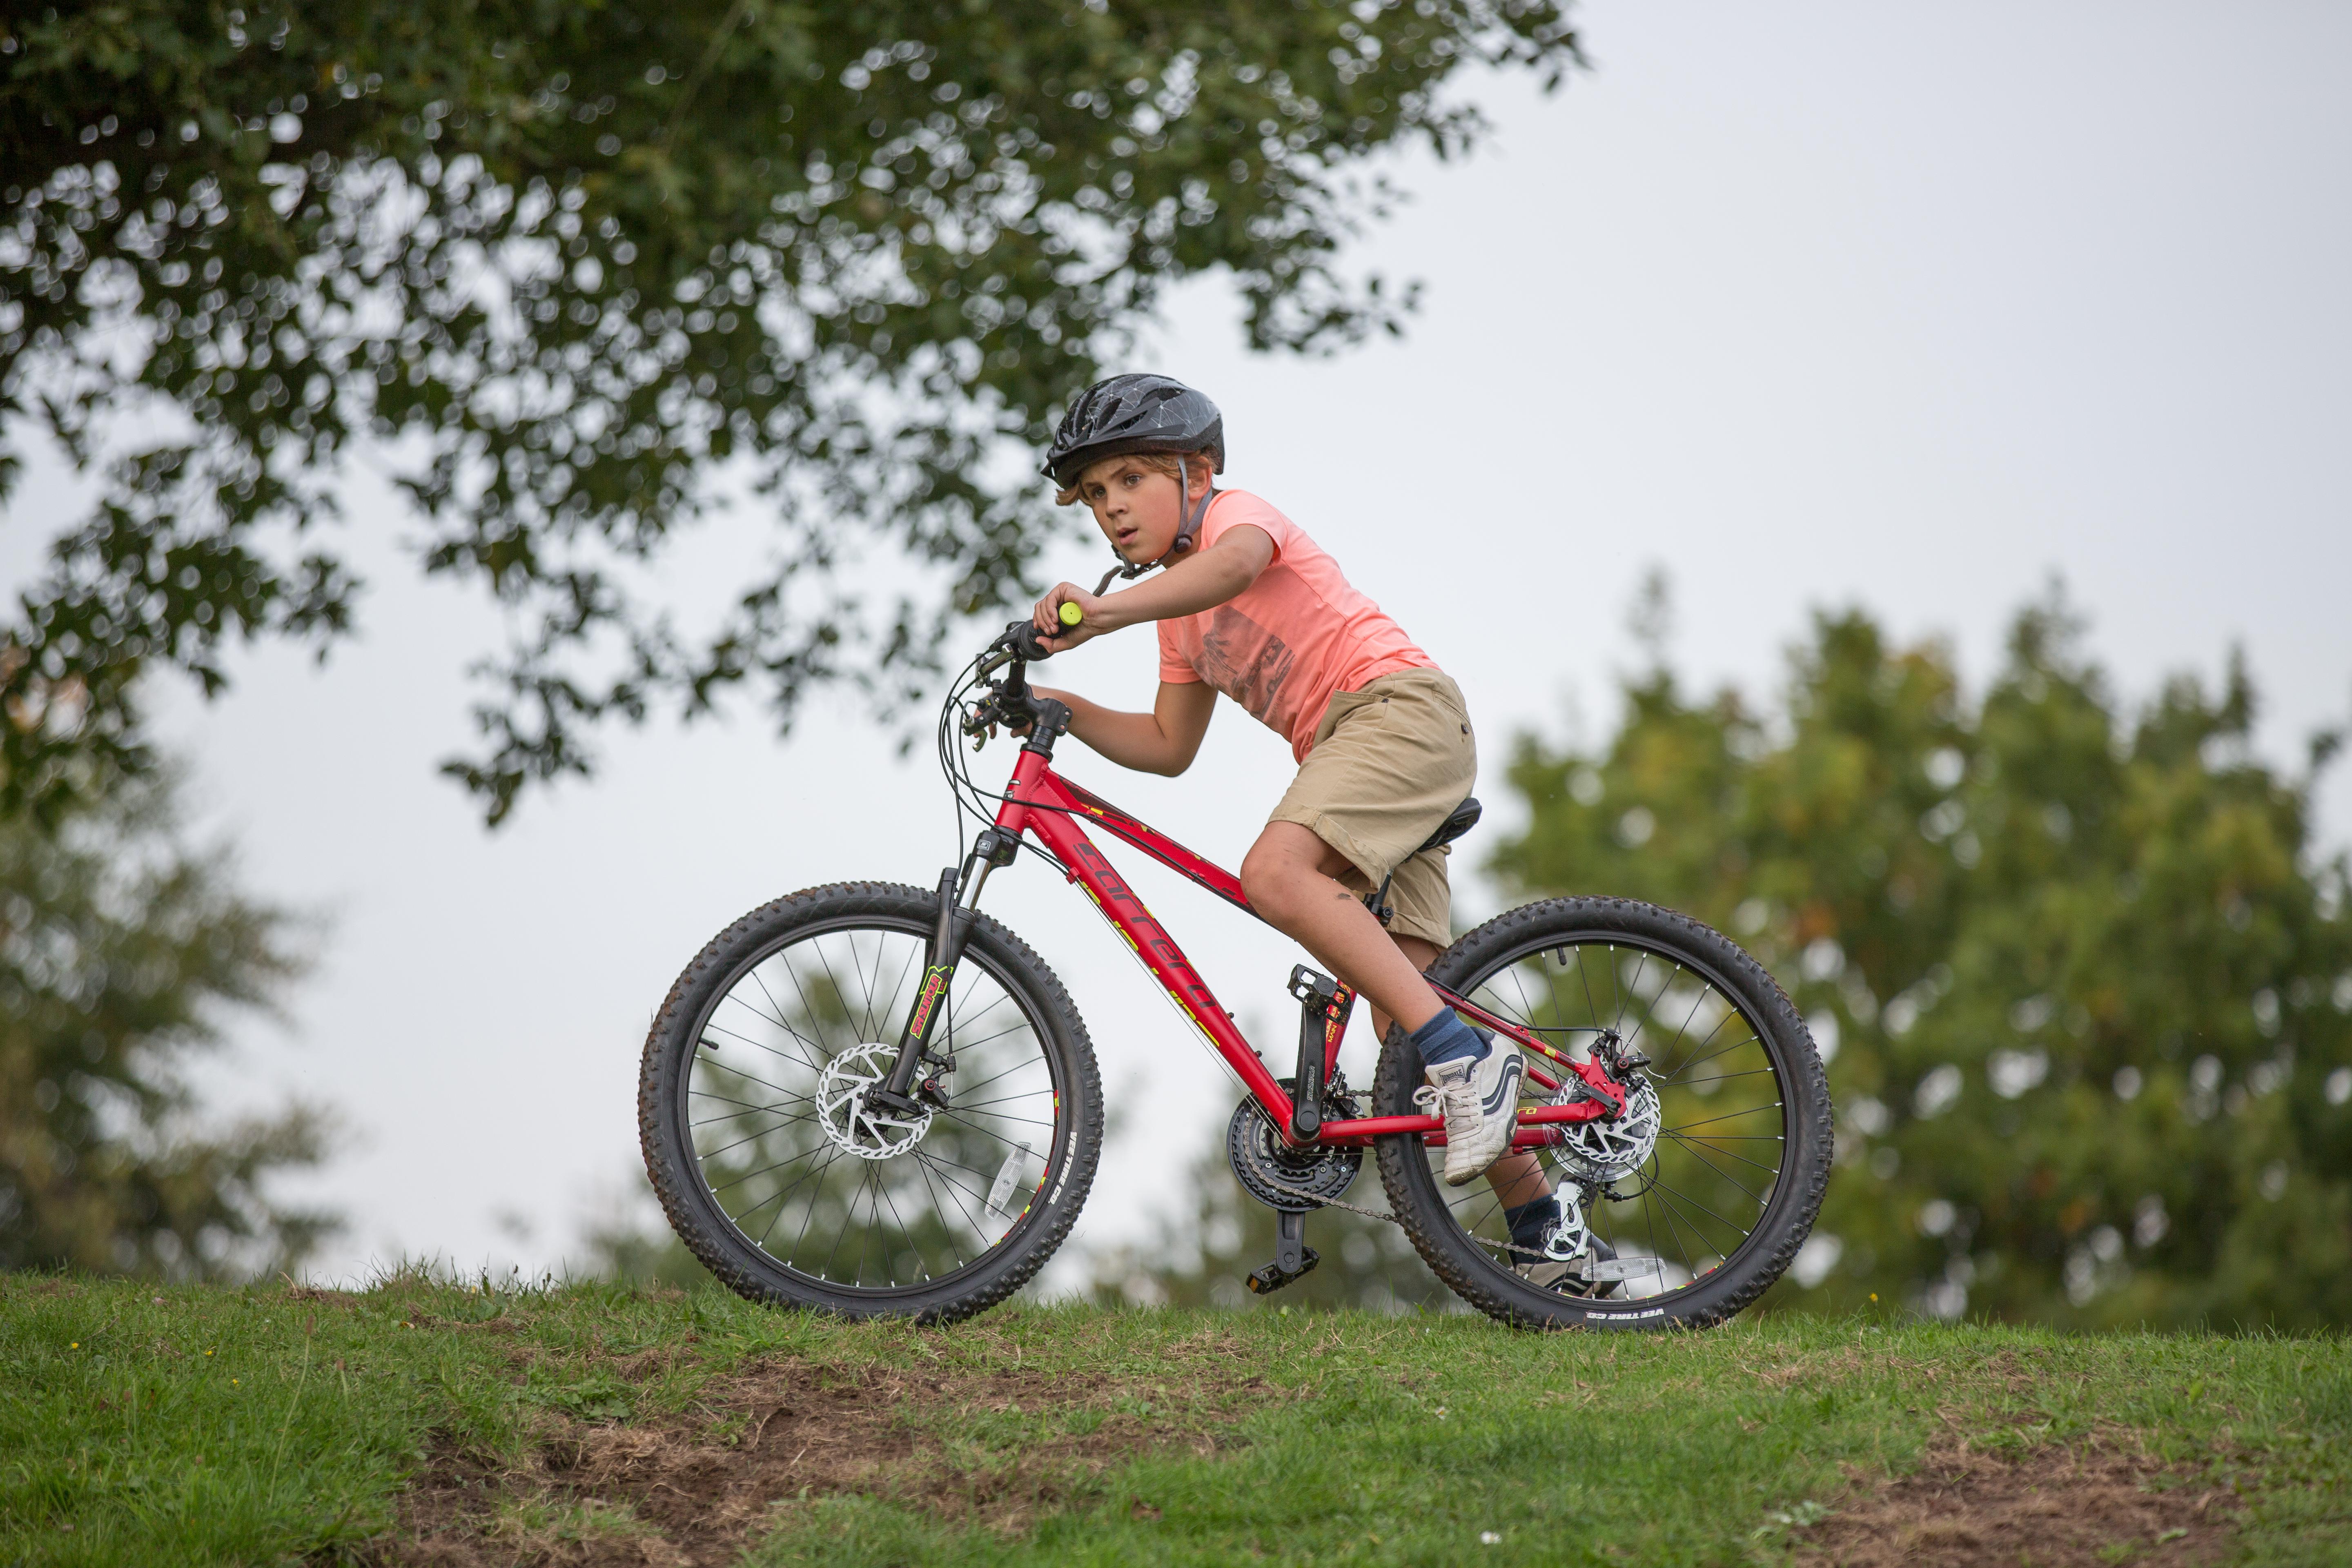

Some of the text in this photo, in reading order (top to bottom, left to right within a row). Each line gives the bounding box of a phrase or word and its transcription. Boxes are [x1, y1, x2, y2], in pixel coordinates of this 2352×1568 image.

[912, 1015, 924, 1036] SR
[918, 975, 940, 1018] SUNTOUR
[1328, 1025, 1337, 1042] MAIN
[1441, 1069, 1465, 1084] LONSDALE
[1048, 1131, 1077, 1205] VEE TIRE CO.
[1640, 1308, 1664, 1319] VEE
